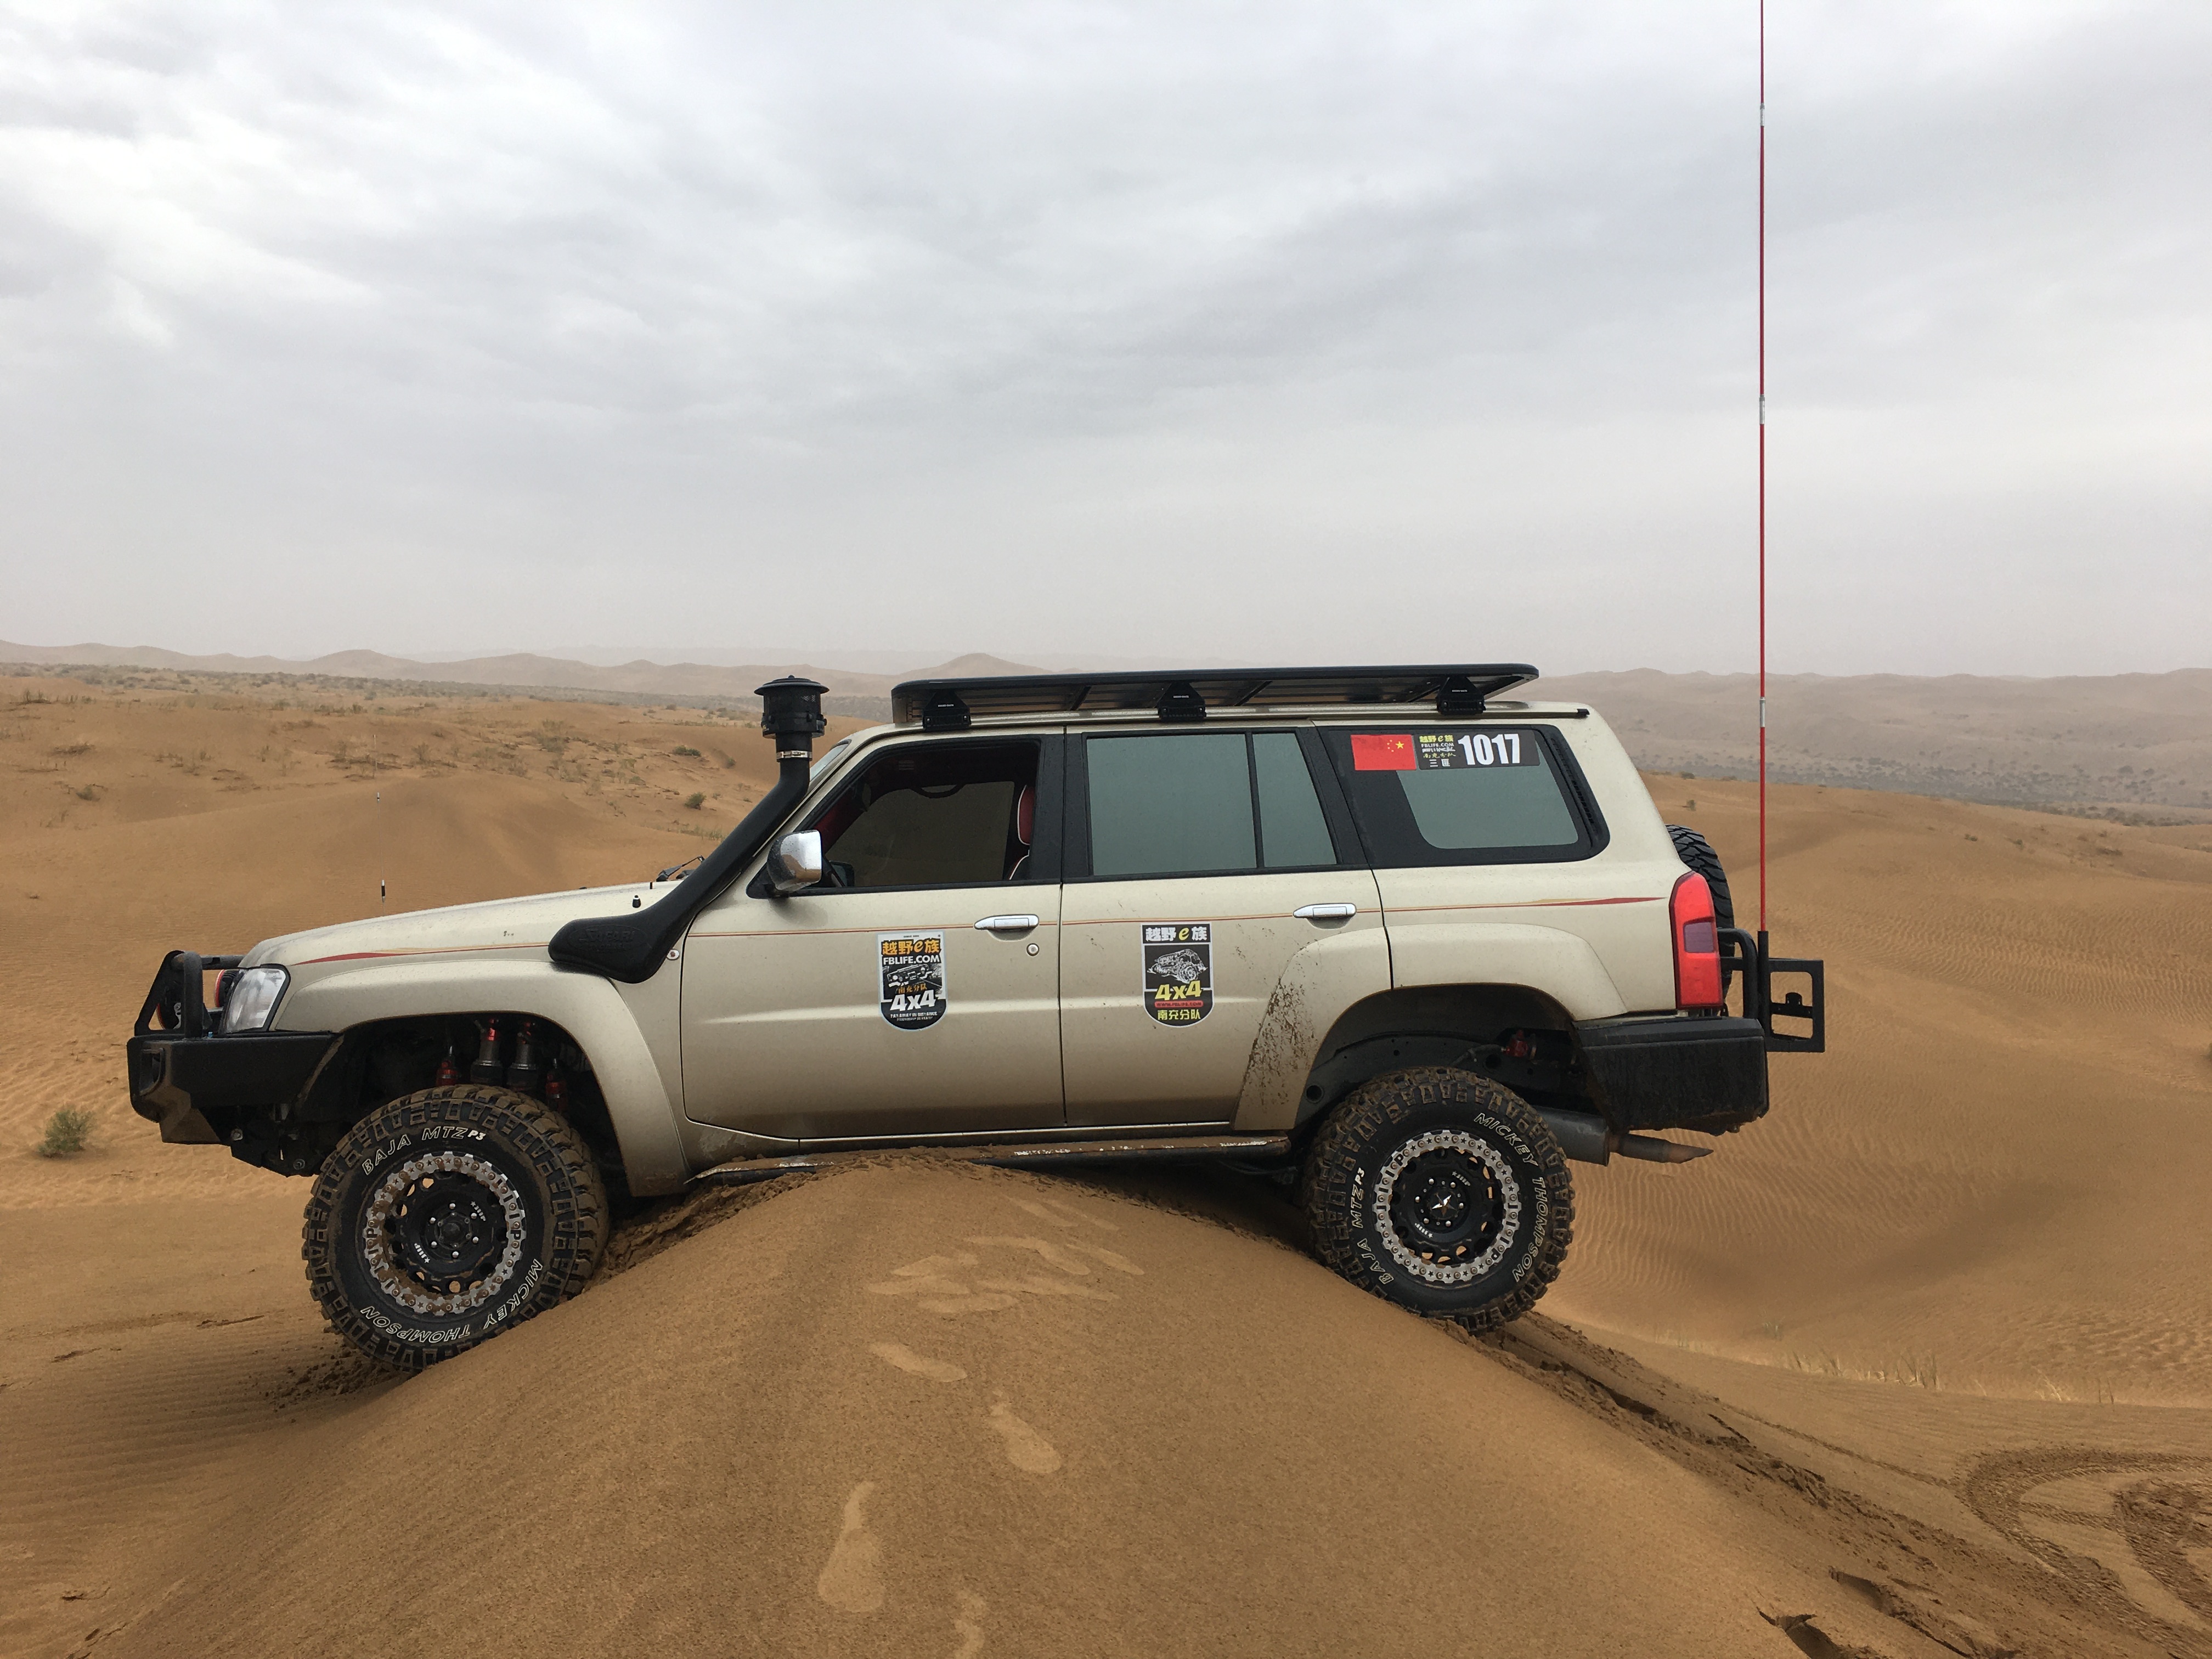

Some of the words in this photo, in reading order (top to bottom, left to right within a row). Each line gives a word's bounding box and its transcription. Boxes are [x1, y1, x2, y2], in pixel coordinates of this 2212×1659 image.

[1458, 733, 1520, 765] 1017
[882, 939, 940, 955] 越野e族
[1146, 926, 1207, 941] 越野e族
[883, 955, 940, 965] FBLIFE.COM
[1158, 1009, 1201, 1020] 南充分队
[362, 1134, 411, 1175] BAJA
[1474, 1113, 1538, 1166] MICKEY
[1512, 1177, 1548, 1283] THOMPSON
[1357, 1238, 1394, 1284] BAJA
[483, 1259, 543, 1329] MICKEY
[361, 1306, 471, 1343] THOMPSON
